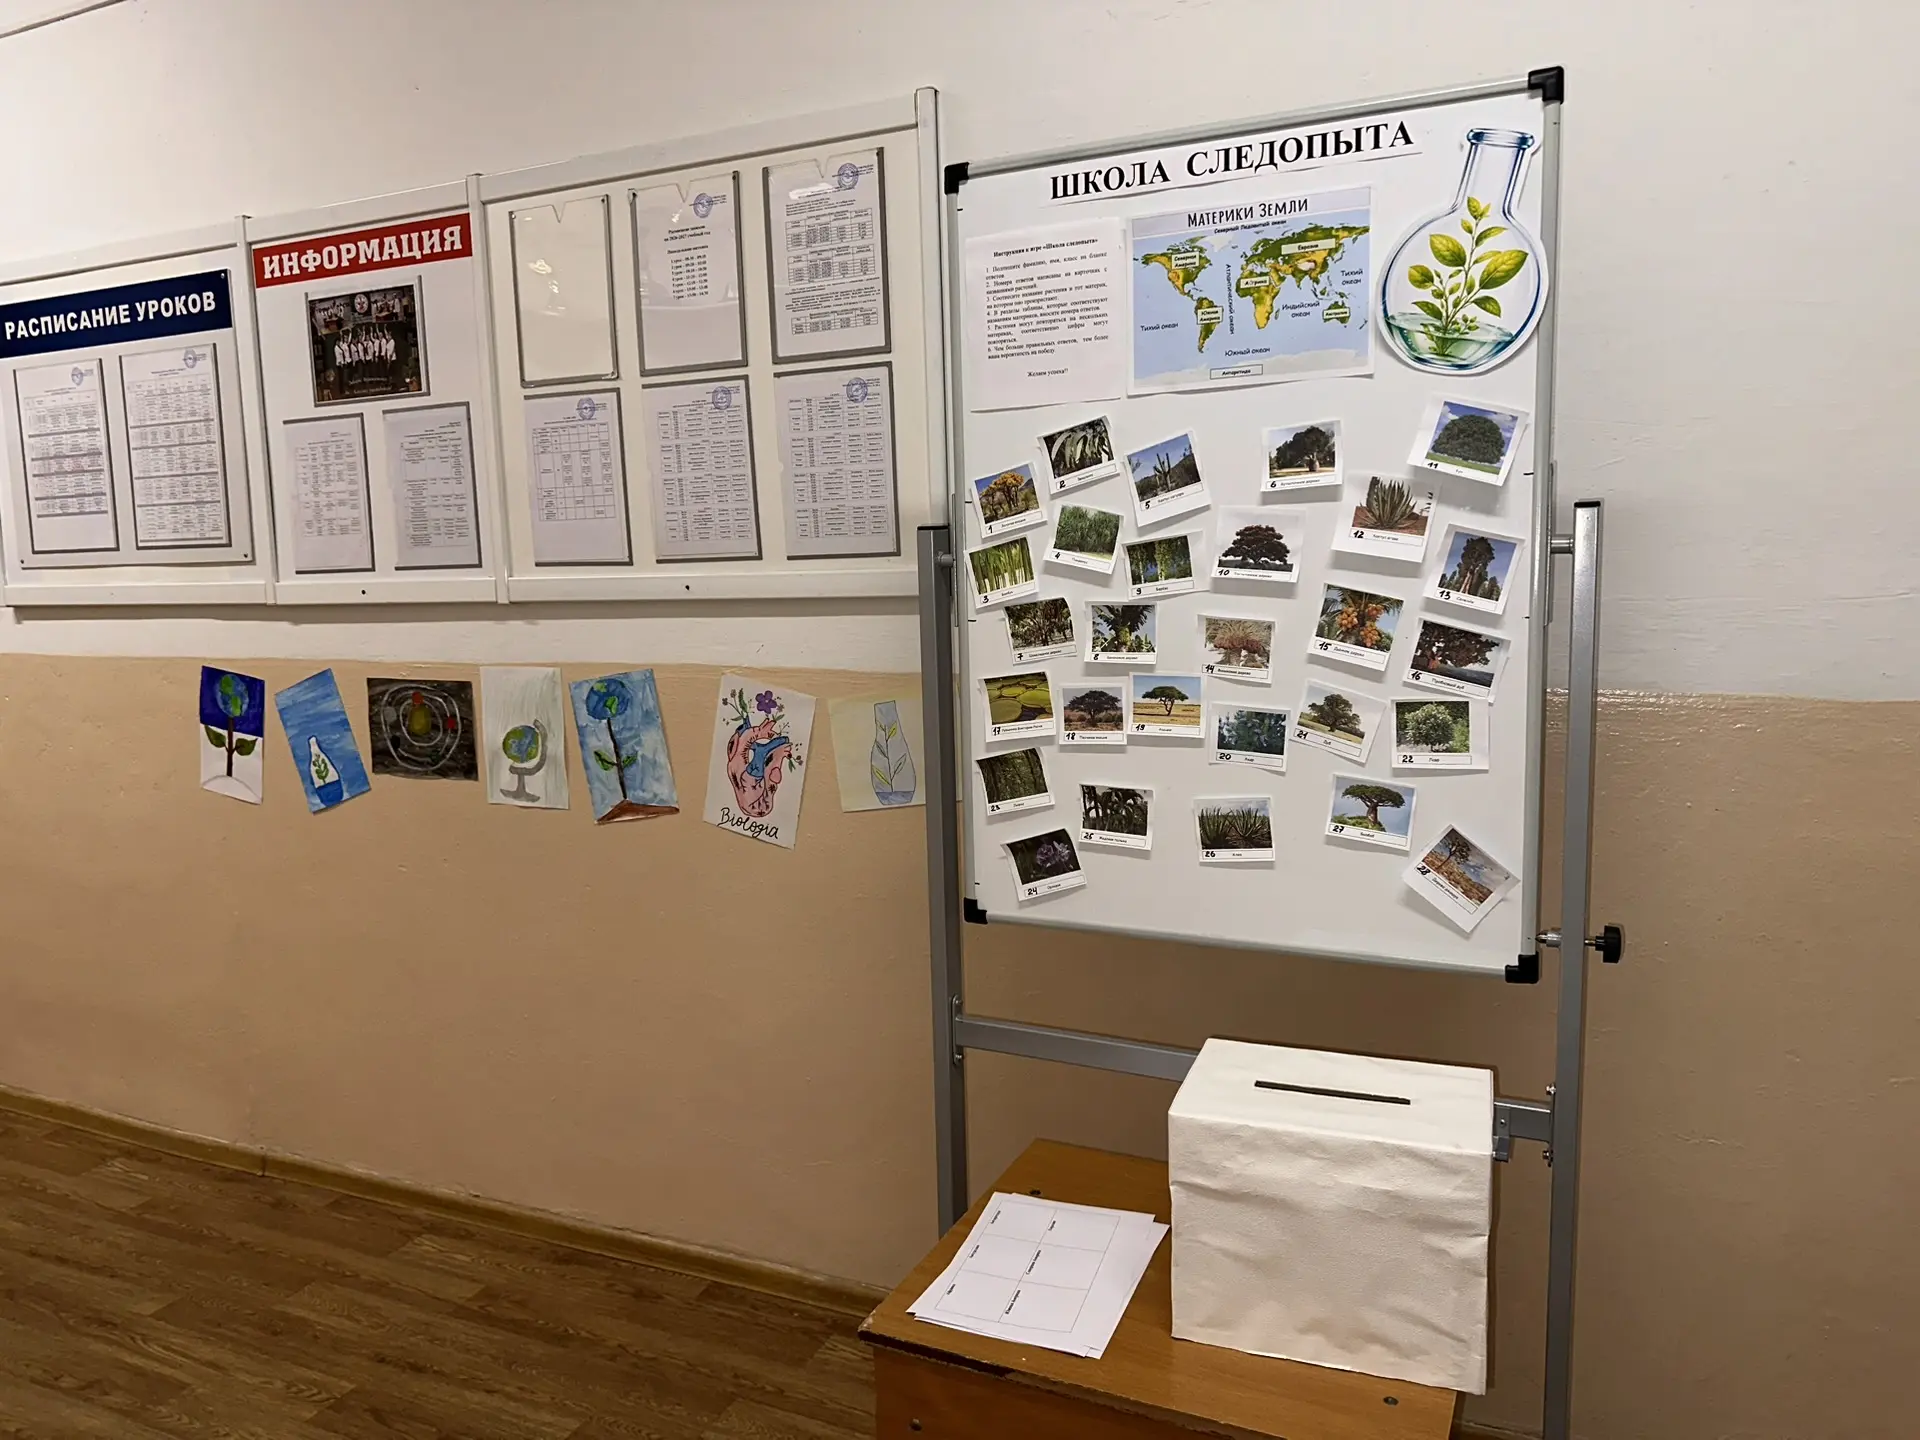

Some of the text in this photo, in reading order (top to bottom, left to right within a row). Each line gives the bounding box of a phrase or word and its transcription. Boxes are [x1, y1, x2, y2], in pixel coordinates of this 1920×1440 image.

[1050, 121, 1414, 200] ШКОЛА СЛЕДОПЫТА
[262, 225, 463, 279] ИНФОРМАЦИЯ
[1340, 268, 1363, 276] Тихий
[1226, 264, 1235, 314] Атлантический
[1282, 301, 1320, 310] Индийский
[4, 291, 216, 340] РАСПИСАНИЕ УРОКОВ
[1140, 324, 1160, 332] Тихий
[1225, 348, 1251, 357] Южный
[1060, 481, 1066, 489] 2
[1145, 500, 1151, 509] 5
[988, 525, 993, 534] 1
[1353, 530, 1365, 539] 12
[1055, 552, 1060, 560] 4
[1218, 569, 1230, 577] 10
[1440, 590, 1451, 601] 13
[1319, 642, 1332, 651] 15
[1018, 653, 1023, 661] 7
[1206, 664, 1215, 674] 14
[1411, 670, 1422, 681] 16
[992, 726, 1001, 736] 17
[1136, 724, 1145, 732] 19
[1066, 732, 1075, 741] 18
[1296, 730, 1309, 740] 21
[1219, 752, 1232, 761] 20
[1402, 755, 1414, 763] 22
[716, 806, 779, 839] Biologia
[1332, 825, 1345, 834] 27
[1084, 832, 1095, 840] 25
[1417, 864, 1431, 876] 28
[1028, 887, 1038, 896] 24
